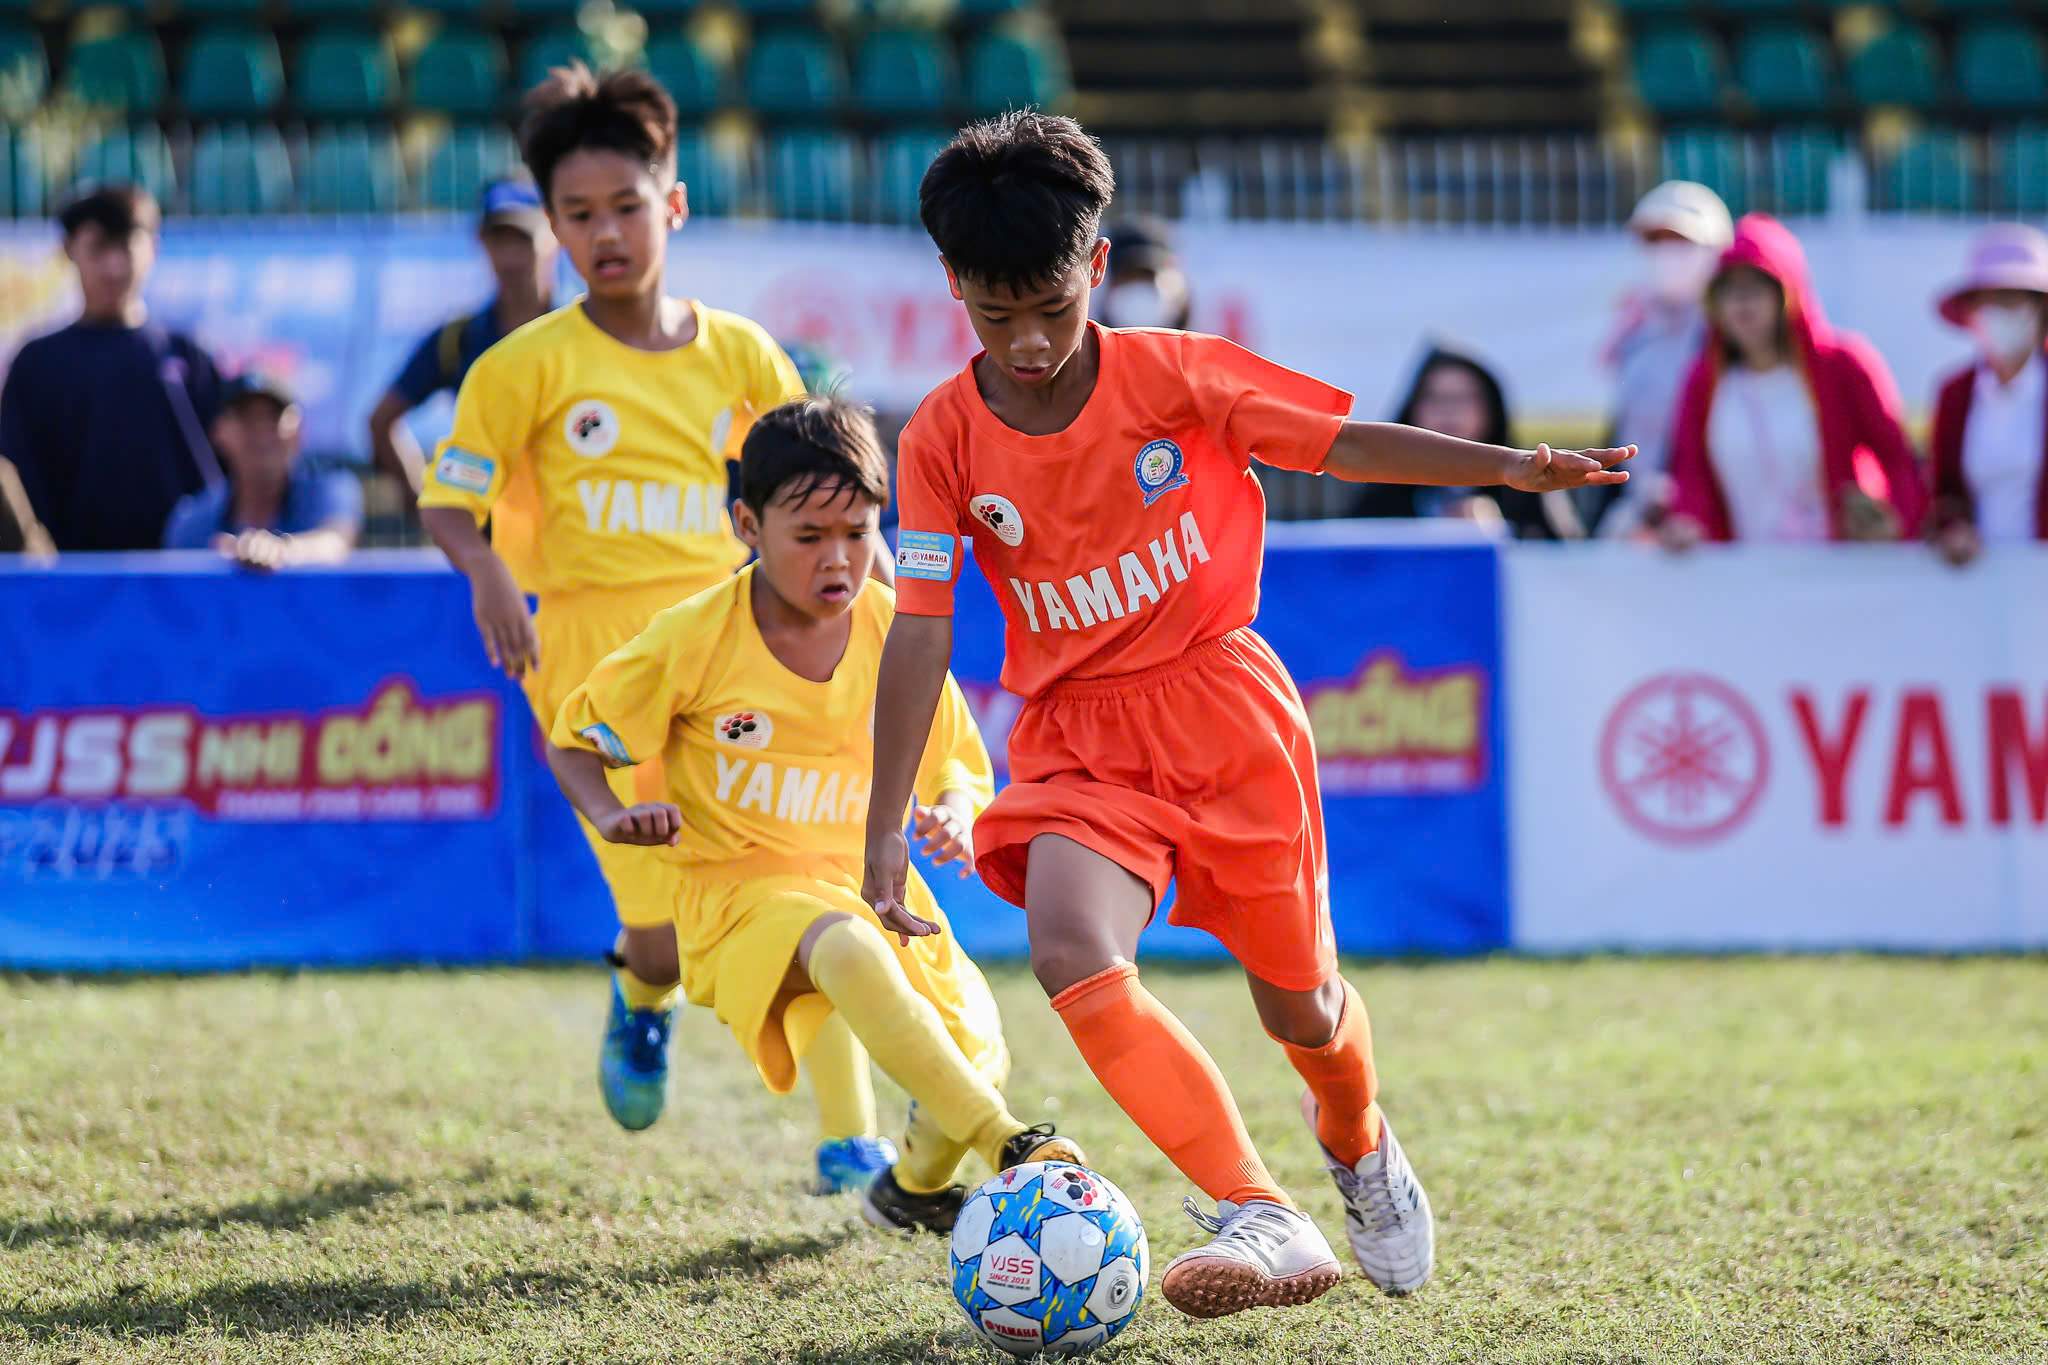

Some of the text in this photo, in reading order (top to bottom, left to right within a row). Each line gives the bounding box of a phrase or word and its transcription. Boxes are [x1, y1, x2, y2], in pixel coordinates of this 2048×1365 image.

[576, 479, 728, 534] YAMAH
[920, 553, 948, 563] YAMAHA
[1009, 510, 1211, 633] YAMAHA
[0, 713, 192, 795] JSS
[715, 752, 873, 824] YAMAH
[989, 1272, 1009, 1282] SINCE
[1010, 1276, 1031, 1285] 2013
[991, 1254, 1034, 1275] VJSS
[994, 1323, 1039, 1337] YAMAHA
